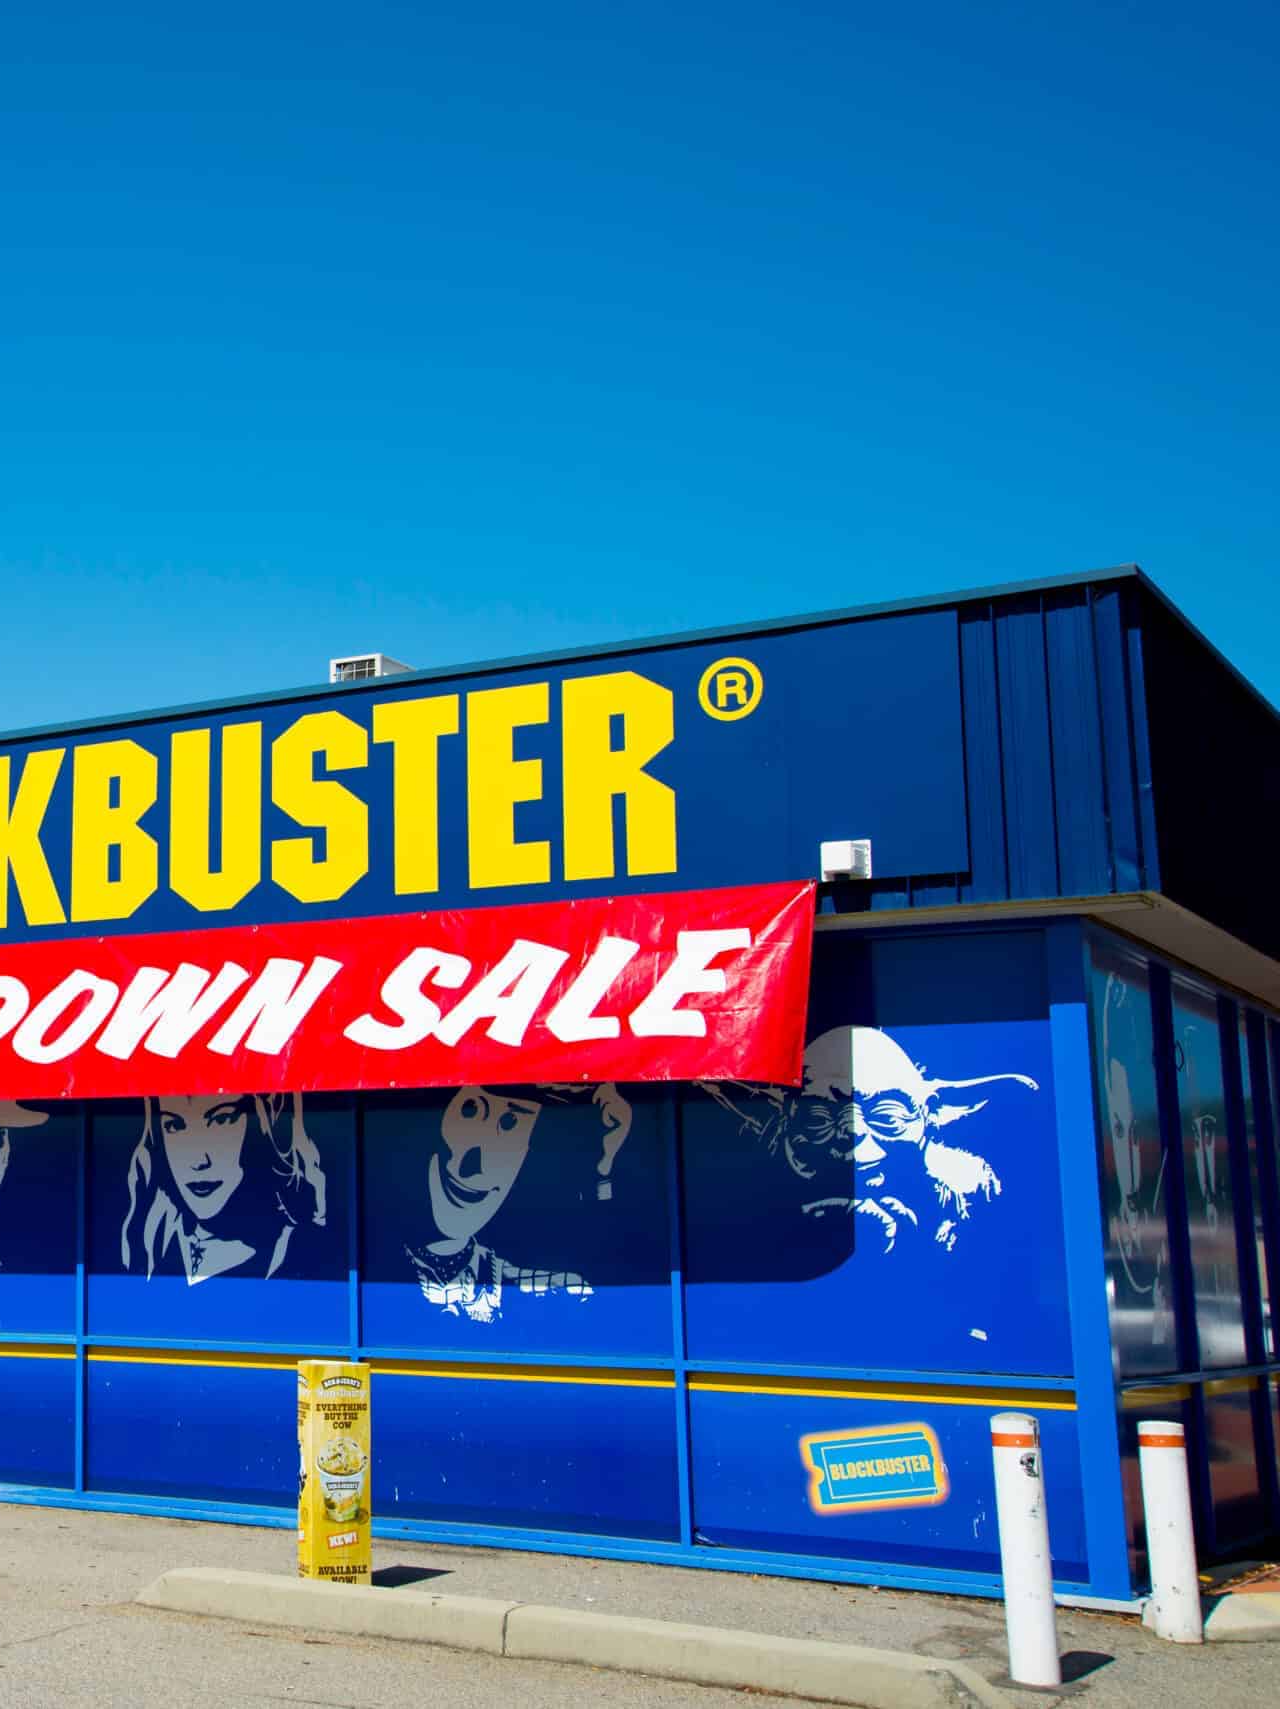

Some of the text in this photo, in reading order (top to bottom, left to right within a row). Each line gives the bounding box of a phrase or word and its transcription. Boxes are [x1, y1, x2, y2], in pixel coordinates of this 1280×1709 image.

[343, 928, 753, 1050] SALE
[316, 1403, 368, 1412] EVERYTHING
[324, 1412, 358, 1421] BUT THE
[332, 1421, 352, 1430] COW
[829, 1454, 931, 1481] BLOCKBUSTER
[318, 1565, 368, 1576] AVAILABLE
